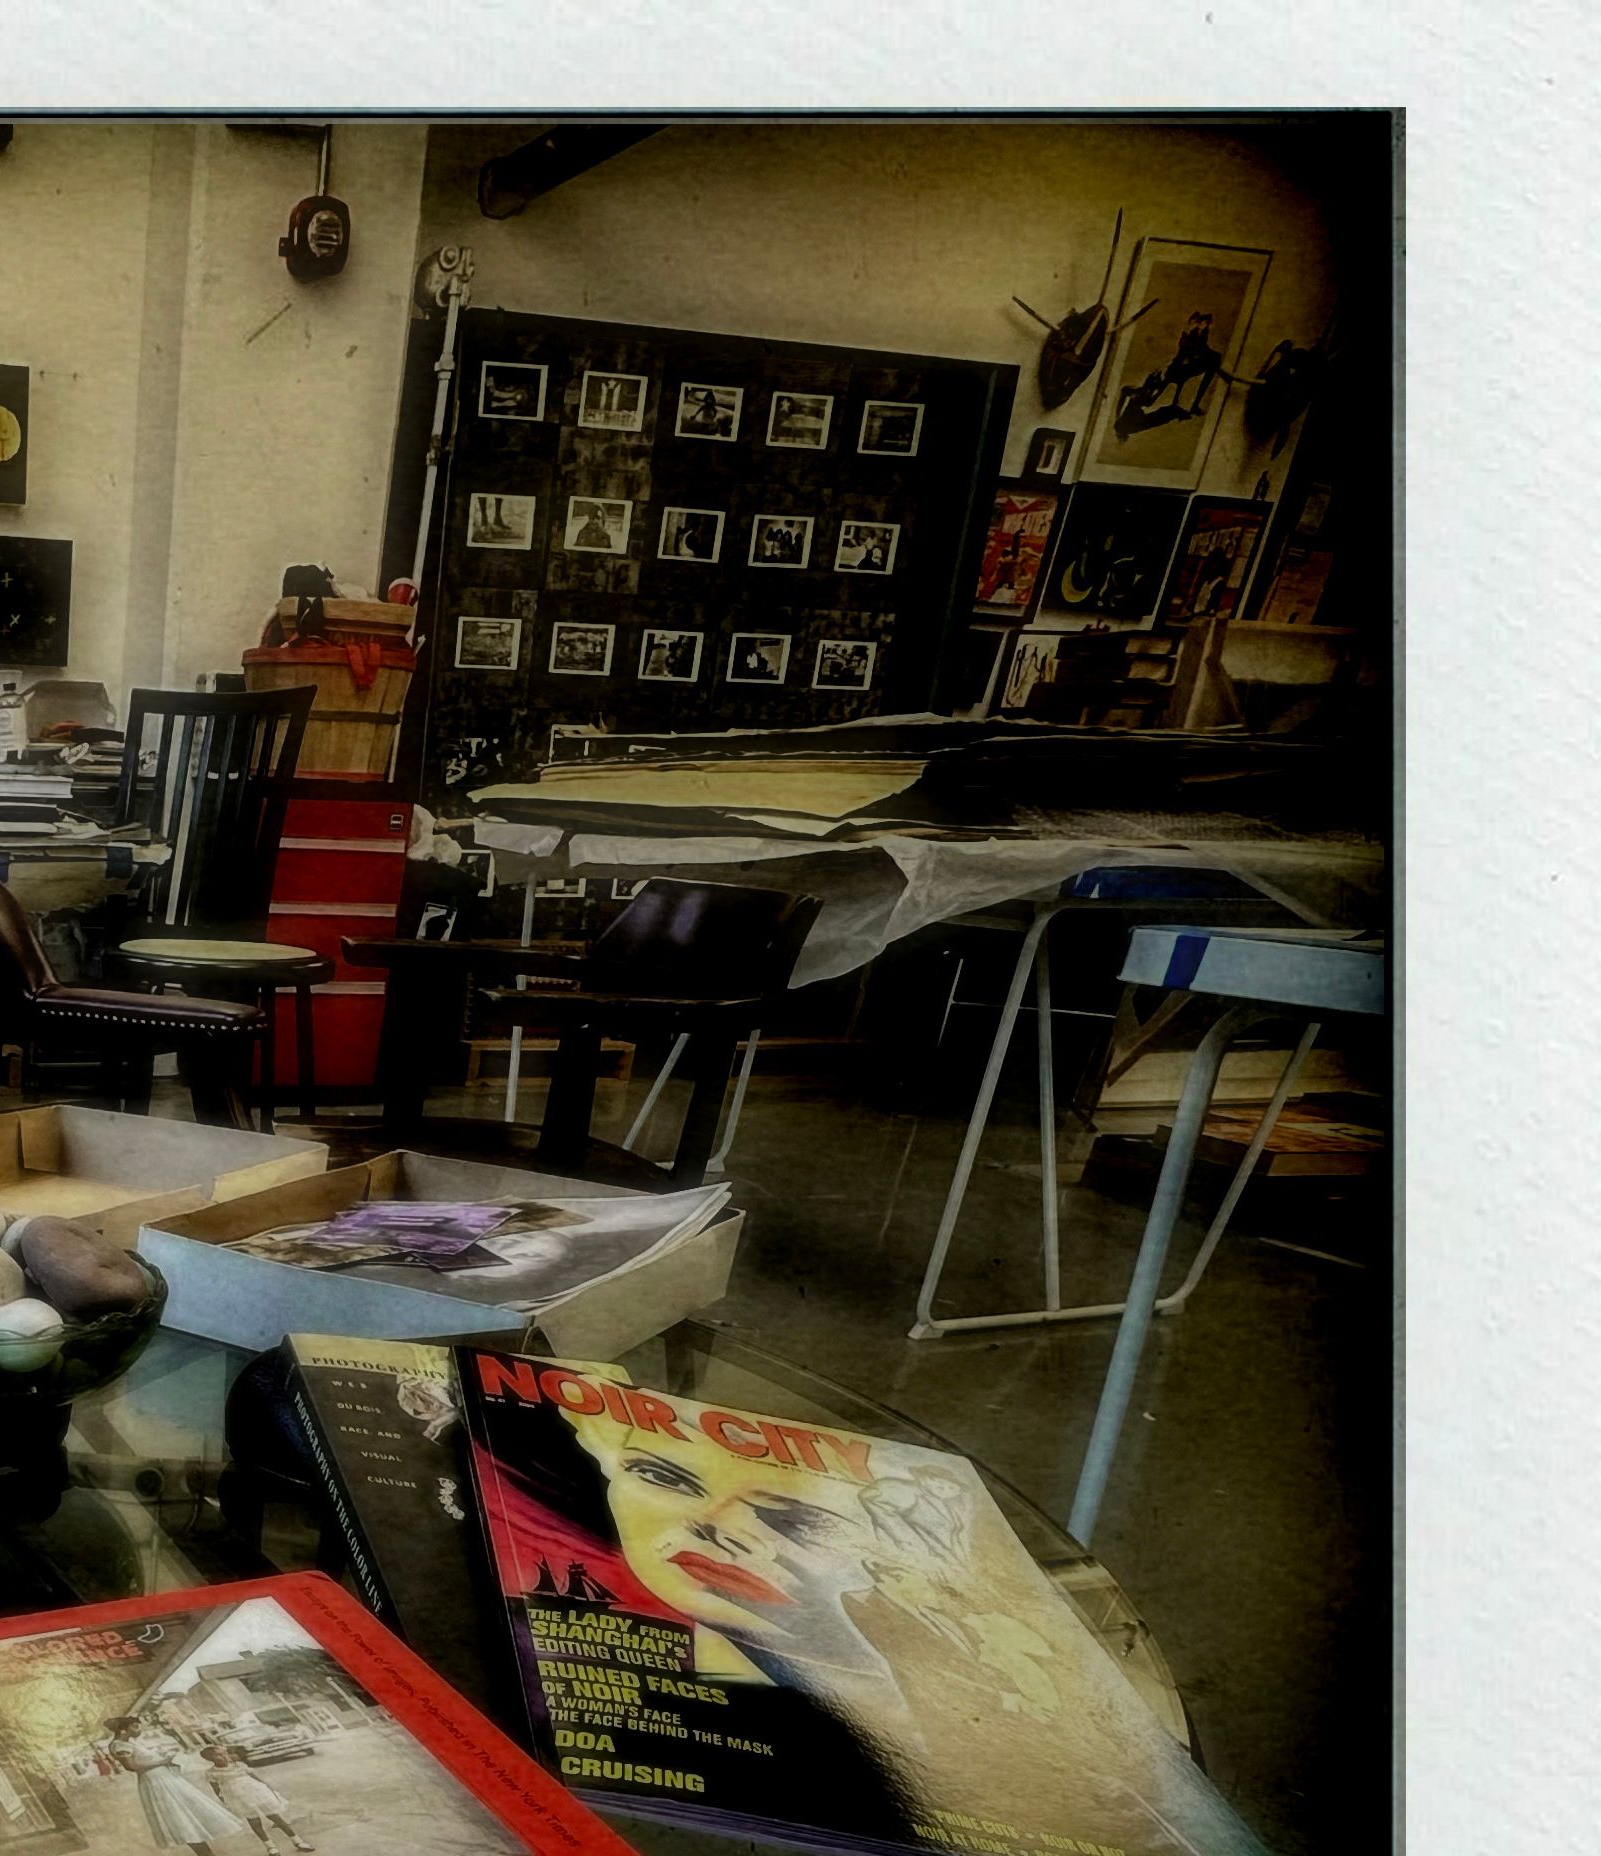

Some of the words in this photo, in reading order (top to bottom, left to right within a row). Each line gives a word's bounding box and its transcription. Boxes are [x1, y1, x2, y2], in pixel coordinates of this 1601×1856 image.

[312, 1357, 446, 1379] PHOTOGRAPHY
[337, 1402, 353, 1411] DU
[474, 1353, 693, 1443] NOIR
[698, 1410, 875, 1484] CITY
[377, 1431, 402, 1440] AND
[360, 1451, 402, 1462] VISUAL
[367, 1475, 418, 1489] CULTURE
[294, 1391, 332, 1481] PHOTOGRAPHY
[327, 1479, 340, 1502] ON
[335, 1498, 351, 1532] THE
[347, 1528, 368, 1581] COLOR
[364, 1576, 383, 1616] LINE
[529, 1608, 562, 1622] THE
[568, 1610, 633, 1632] LADY
[639, 1624, 690, 1645] FROM
[533, 1637, 612, 1660] EDITING
[616, 1648, 682, 1673] QUEEN
[537, 1660, 641, 1688] RUINED
[646, 1675, 730, 1706] FACES
[541, 1681, 566, 1695] OF
[572, 1681, 643, 1706] NOIR
[546, 1696, 556, 1707] A
[561, 1697, 639, 1718] WOMAN'S
[643, 1708, 681, 1725] FACE
[351, 1633, 377, 1656] Power
[475, 1750, 497, 1769] The
[494, 1769, 521, 1792] New
[521, 1792, 548, 1815] York
[545, 1814, 582, 1848] Times
[549, 1709, 580, 1723] THE
[584, 1714, 623, 1729] FACE
[627, 1720, 688, 1739] BEHIND
[693, 1729, 722, 1746] THE
[727, 1736, 774, 1757] MASK
[555, 1729, 616, 1752] DOA
[561, 1756, 705, 1792] CRUISING
[912, 1823, 950, 1843] NOIR
[950, 1831, 970, 1848] AT
[971, 1836, 1015, 1856] HOME
[934, 1809, 982, 1831] PRIME
[981, 1819, 1020, 1839] CUTS
[1039, 1832, 1078, 1851] NOIR
[1076, 1840, 1098, 1856] OR
